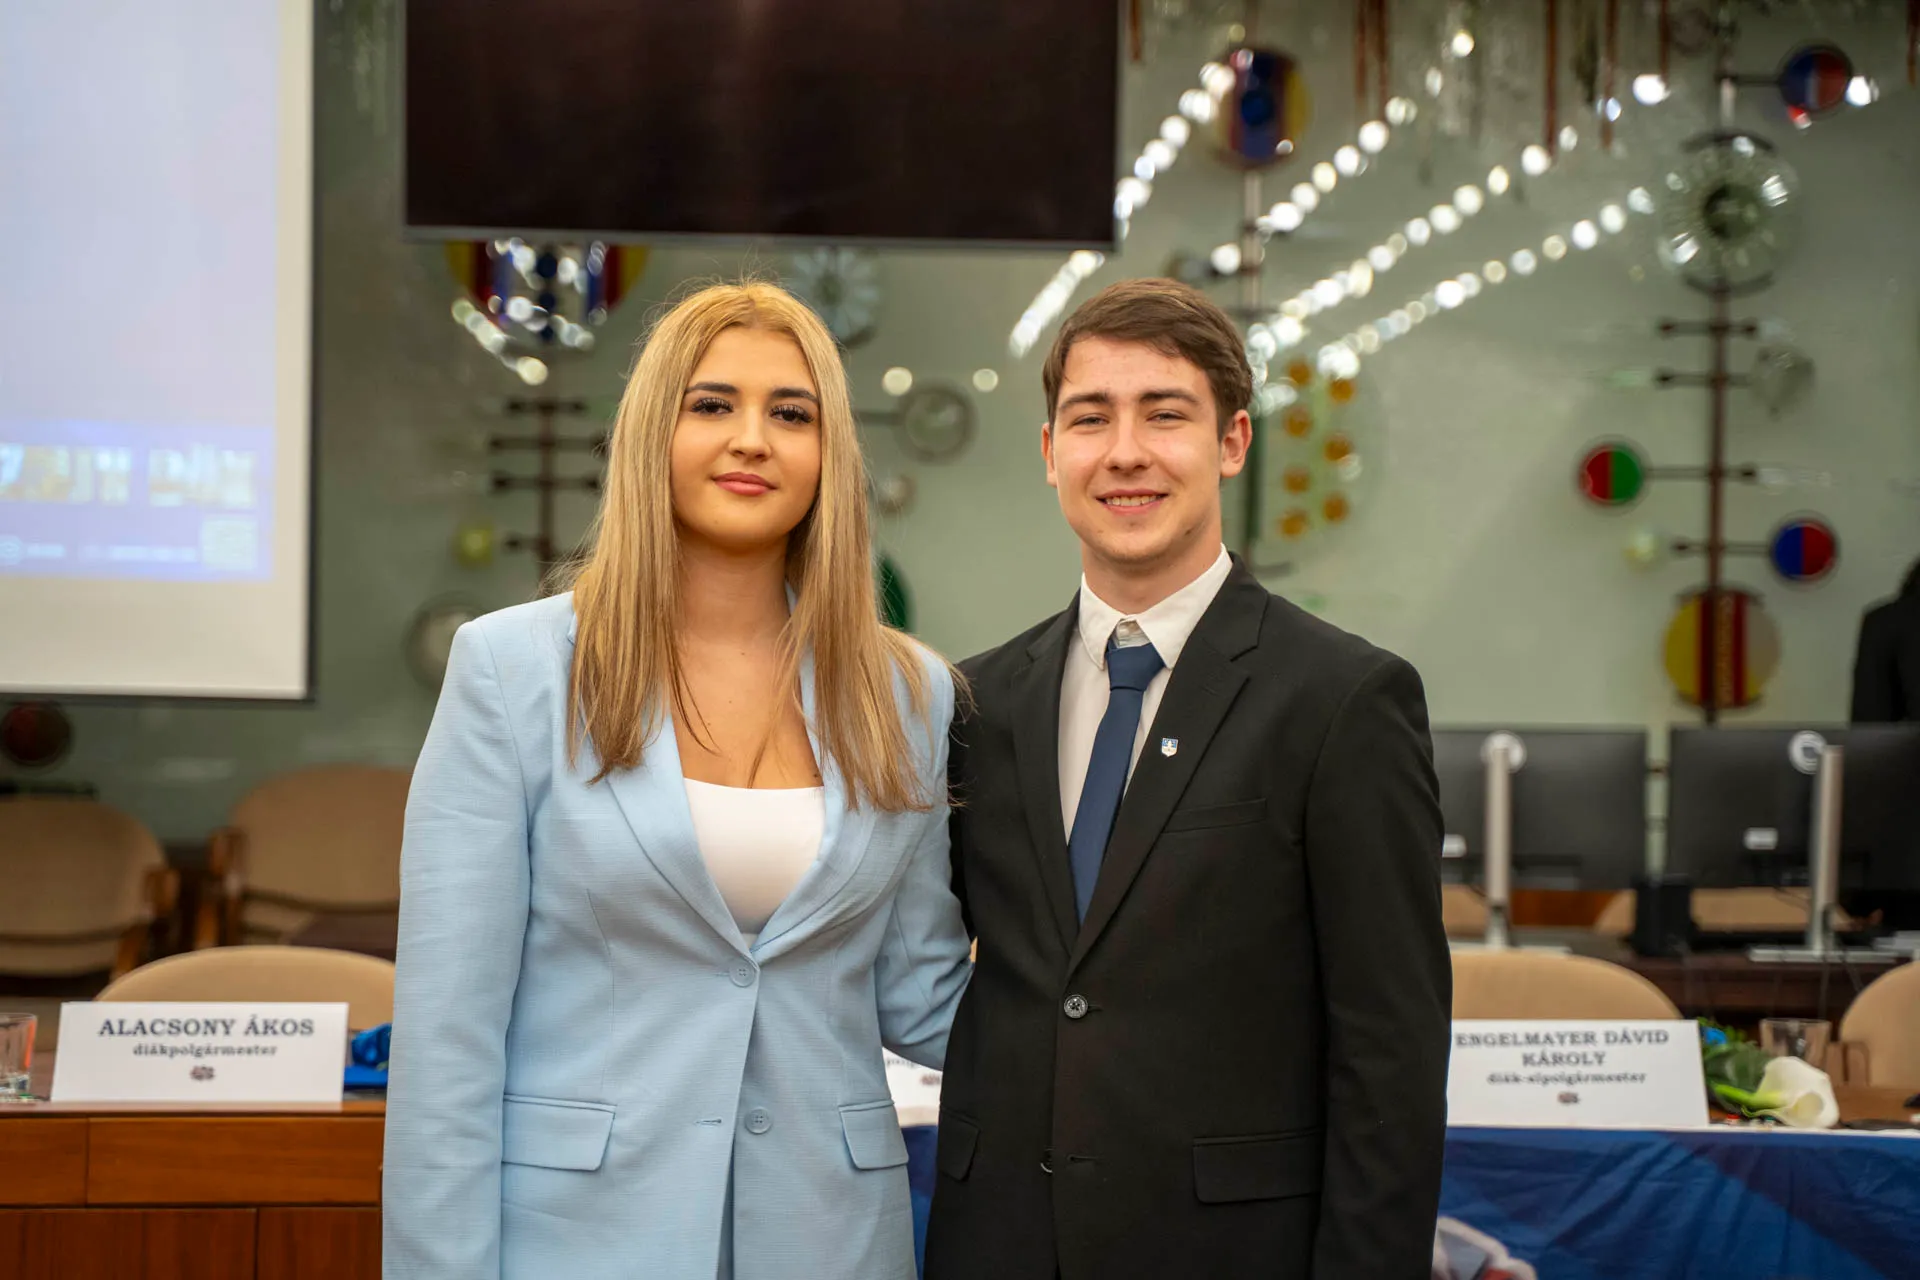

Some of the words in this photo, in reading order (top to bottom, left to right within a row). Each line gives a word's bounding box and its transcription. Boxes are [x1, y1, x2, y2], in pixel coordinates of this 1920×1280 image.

[99, 1018, 236, 1037] ALACSONY
[244, 1015, 315, 1036] ÁKOS
[1455, 1031, 1598, 1047] ENGELMAYER
[1604, 1027, 1669, 1045] DÁVID
[1522, 1049, 1606, 1067] KÁROLY
